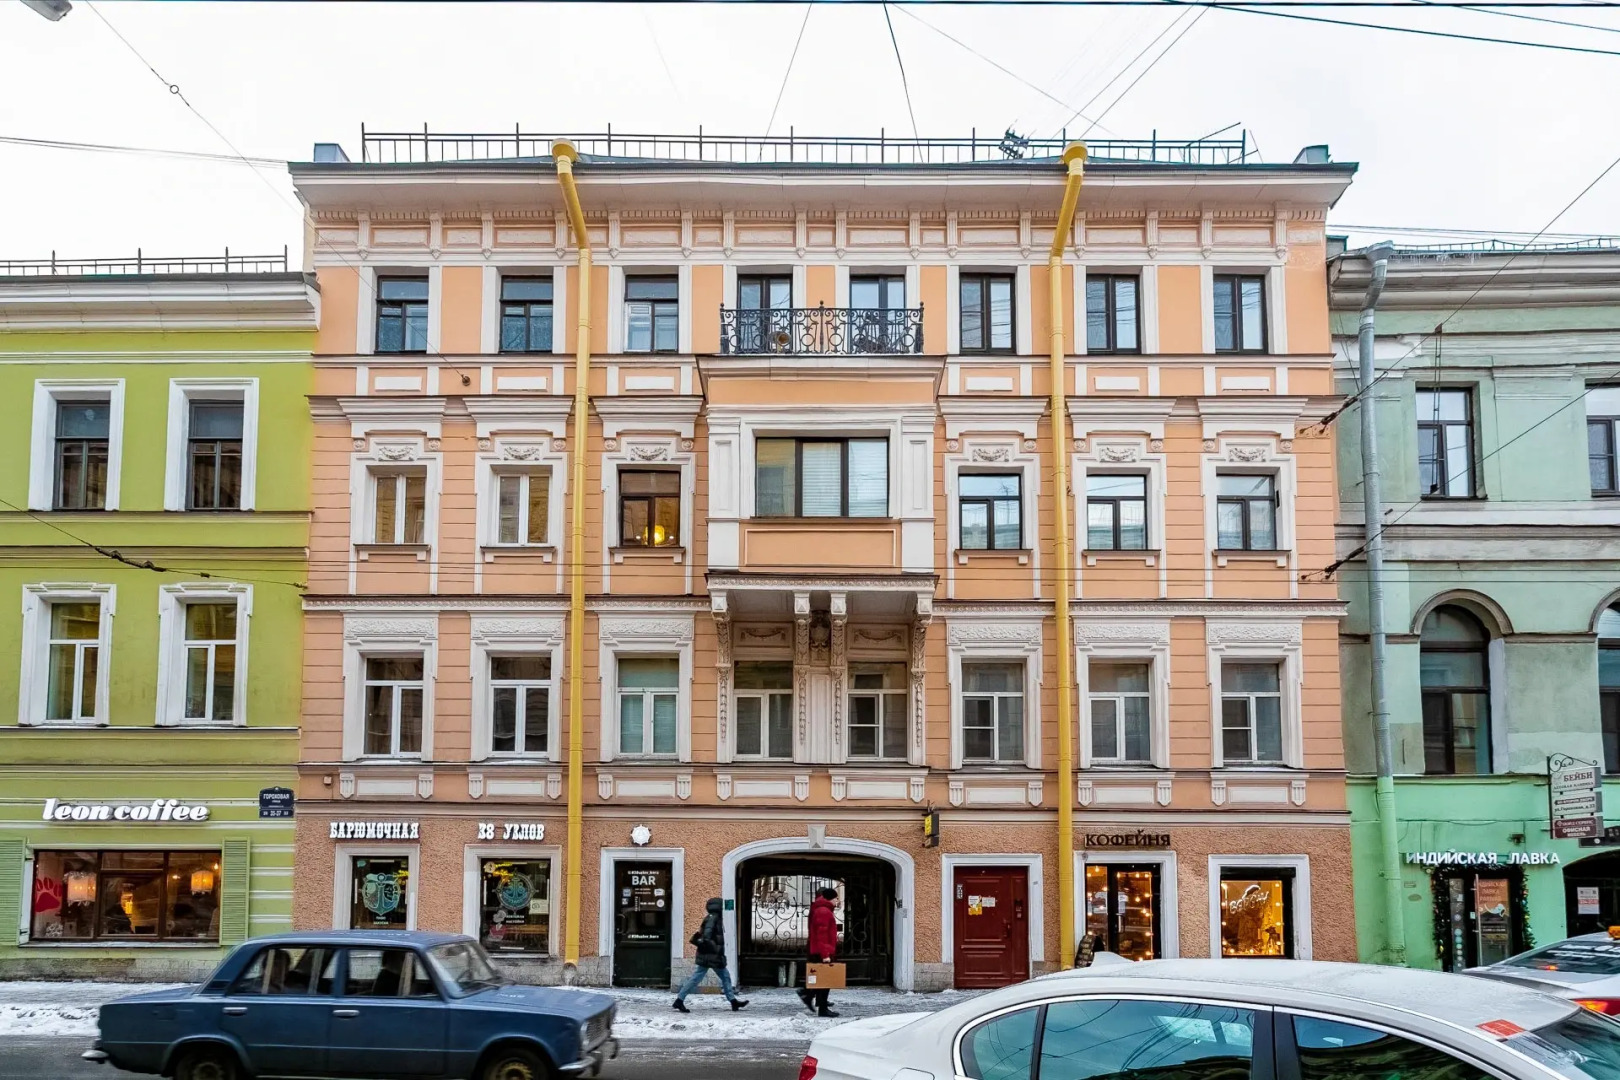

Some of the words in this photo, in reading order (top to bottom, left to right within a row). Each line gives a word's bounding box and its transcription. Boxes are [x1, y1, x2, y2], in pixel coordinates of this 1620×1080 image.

[42, 798, 110, 821] leon
[113, 799, 209, 821] coffee
[329, 822, 420, 839] БАРЮМОЧНАЯ
[503, 823, 545, 840] УЗЛОВ
[1085, 829, 1171, 847] КОФЕЙНЯ
[1406, 849, 1498, 865] ИНДИЙСКАЯ
[1507, 852, 1560, 865] ЛАВКА
[631, 875, 656, 886] BAR
